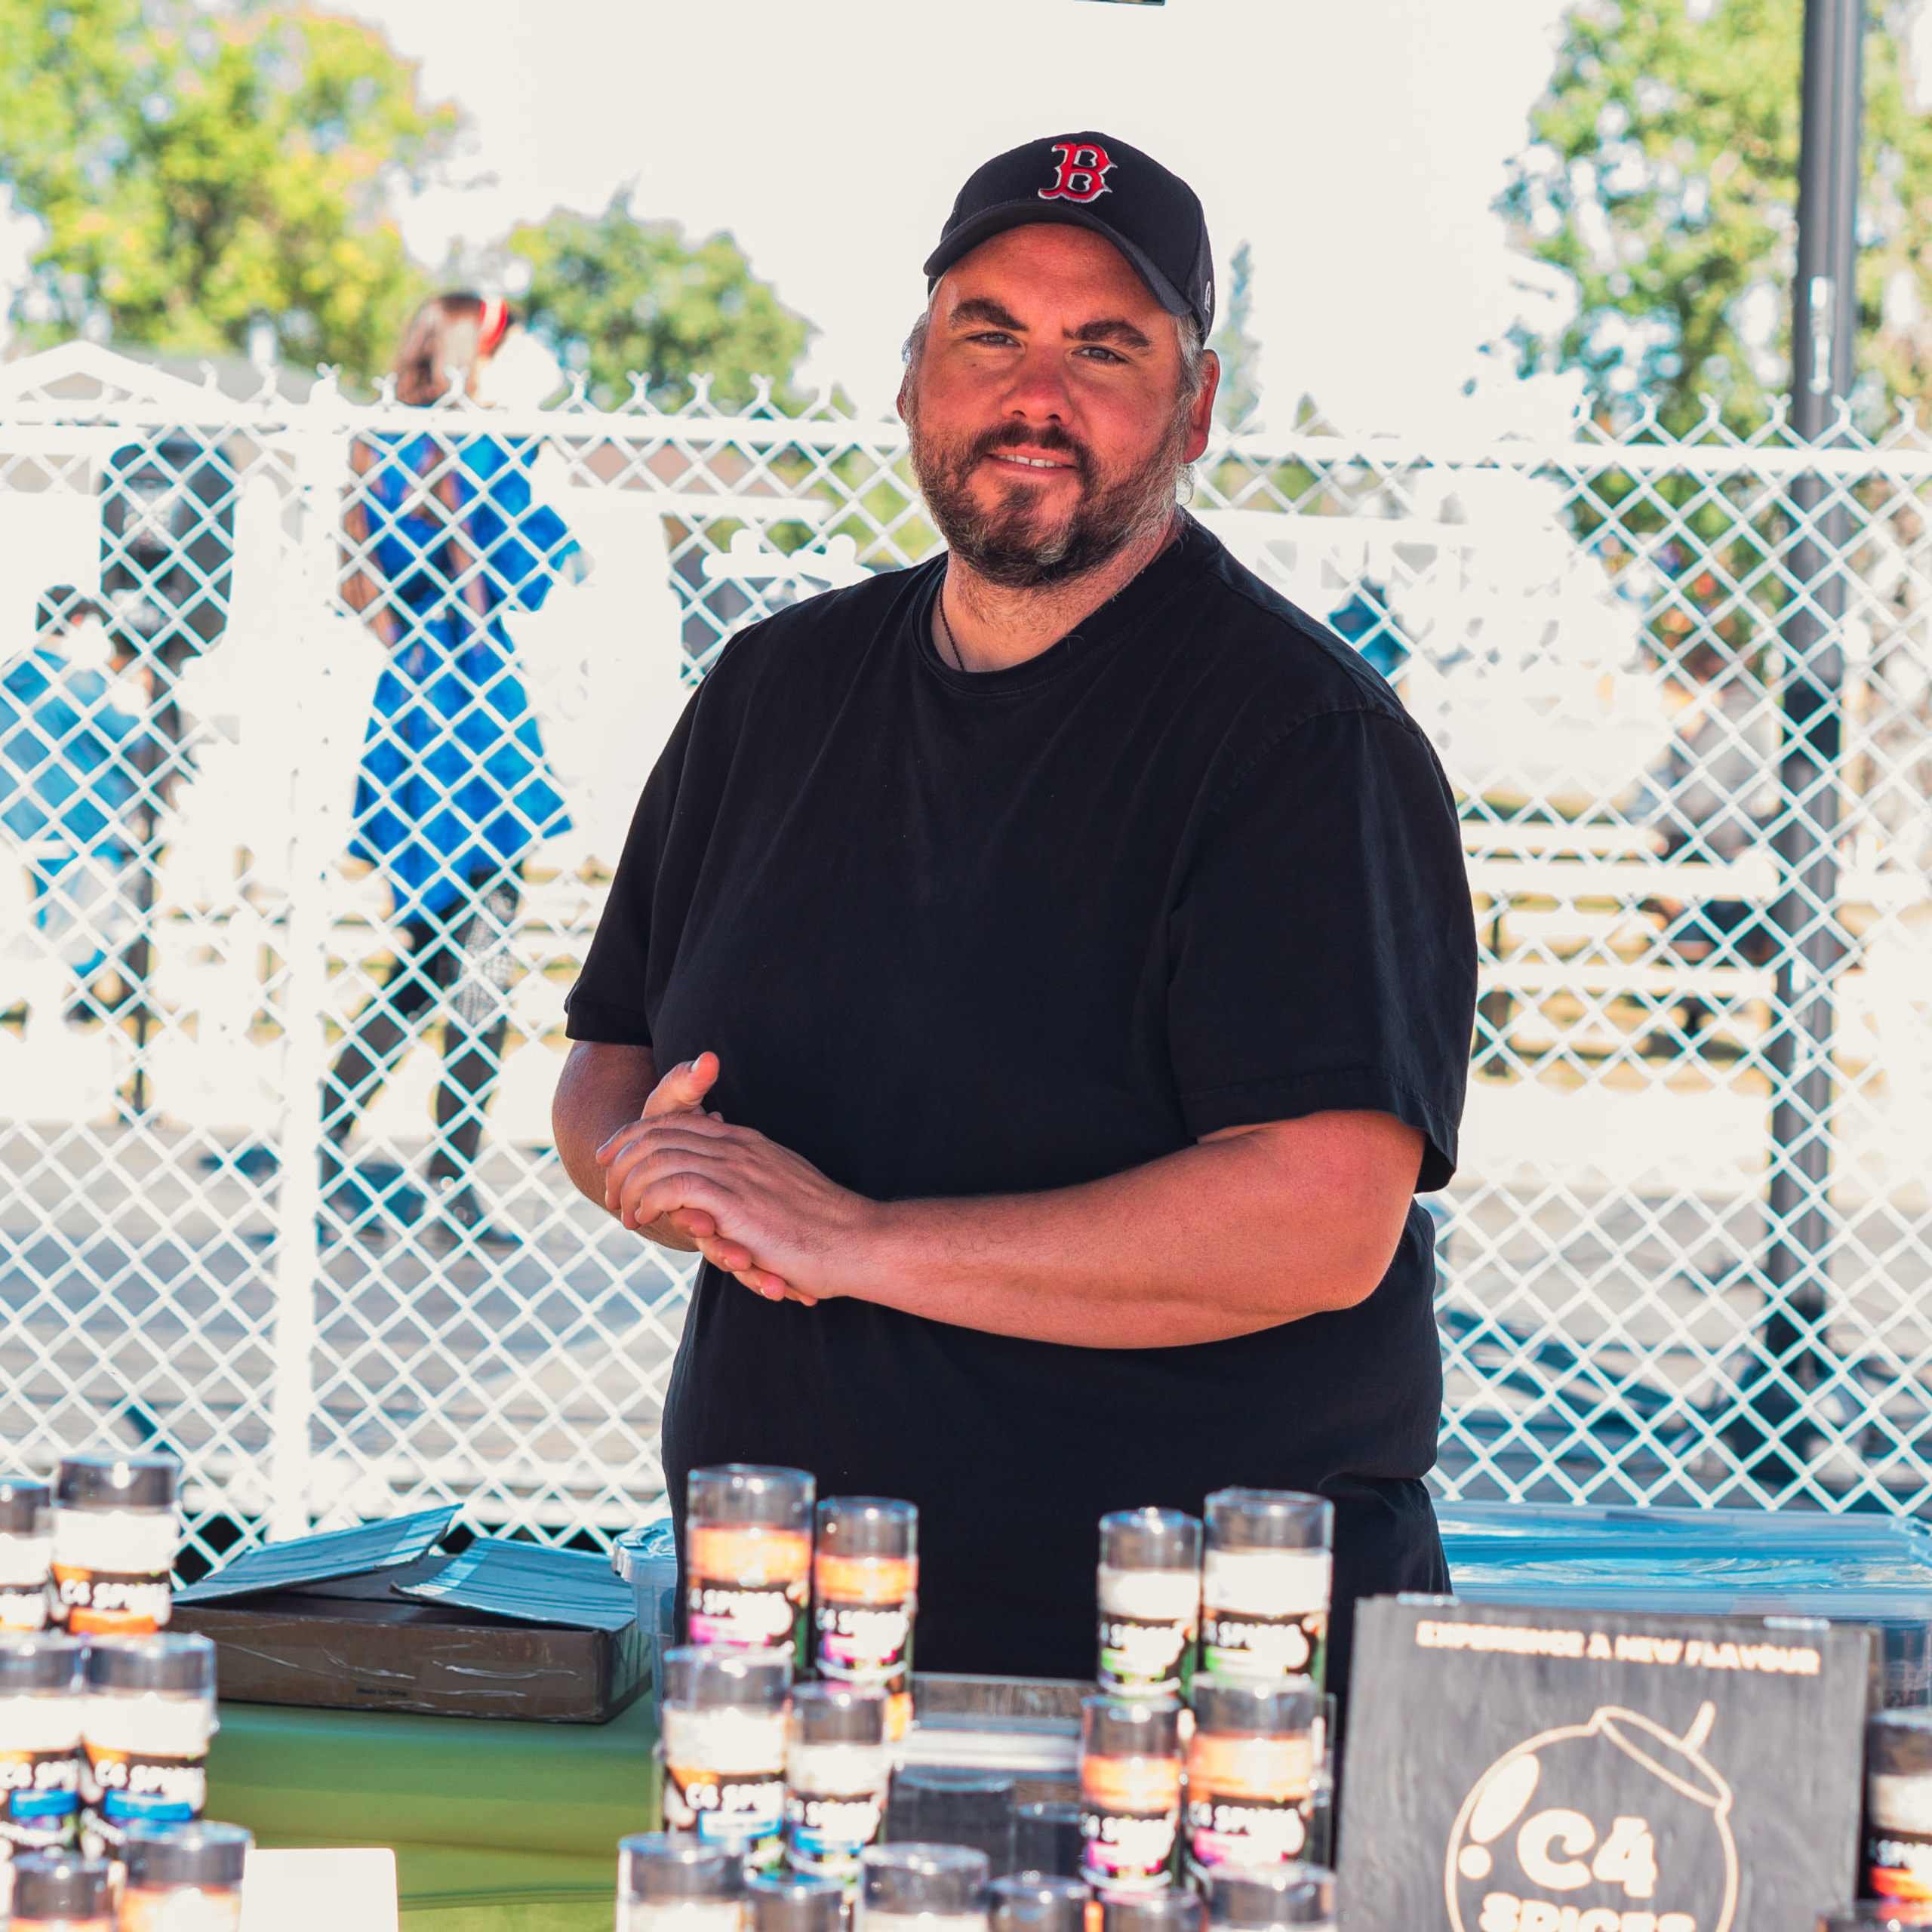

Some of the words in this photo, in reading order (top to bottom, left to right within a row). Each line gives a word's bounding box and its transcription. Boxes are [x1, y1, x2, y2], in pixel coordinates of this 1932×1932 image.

[1038, 143, 1118, 203] B
[1416, 1620, 1585, 1658] EXPERIENCE
[1586, 1632, 1612, 1660] A
[1615, 1635, 1683, 1665] NEW
[1684, 1639, 1820, 1675] FLAVOUR
[1517, 1808, 1658, 1897] C4
